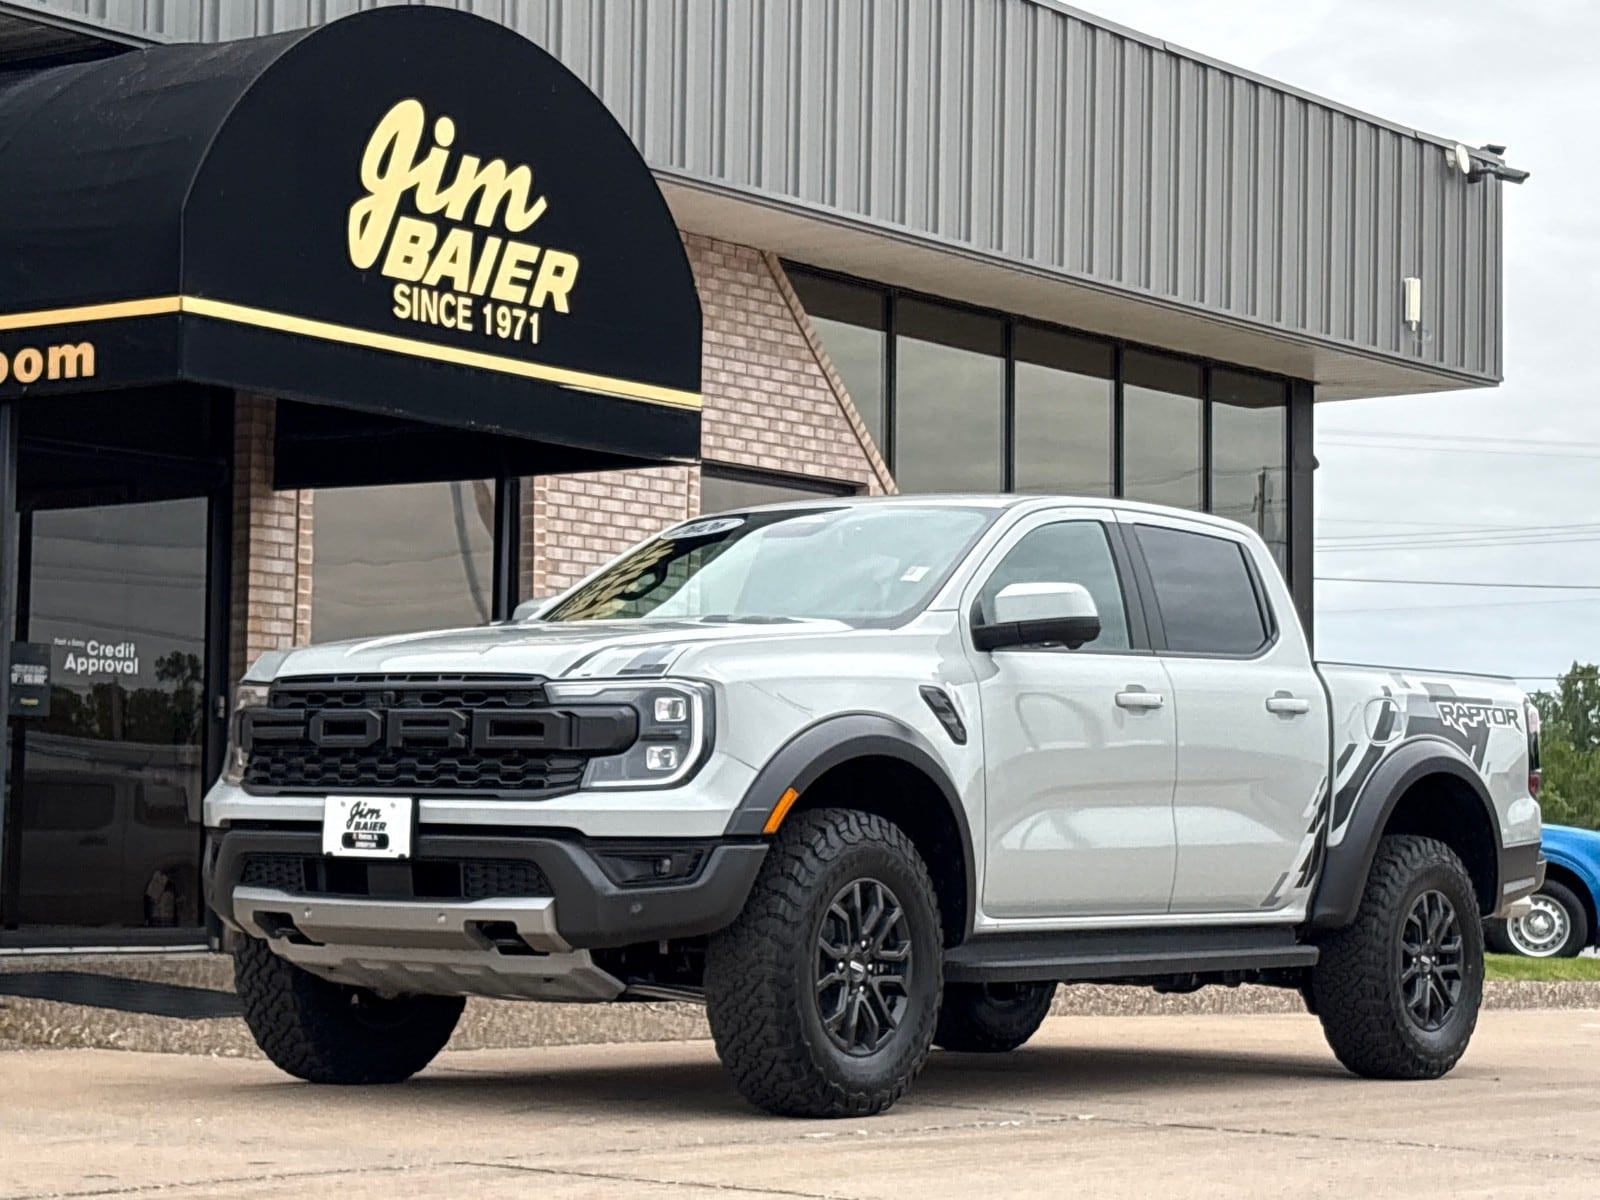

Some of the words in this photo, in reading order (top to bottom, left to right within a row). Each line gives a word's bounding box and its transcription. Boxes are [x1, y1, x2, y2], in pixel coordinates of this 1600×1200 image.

[348, 99, 548, 269] Jim
[381, 216, 579, 314] BAIER
[393, 283, 473, 332] SINCE
[483, 303, 540, 345] 1971
[0, 342, 95, 384] om
[63, 652, 139, 675] Approval
[86, 640, 136, 659] Credit
[239, 708, 571, 752] FORD
[1436, 701, 1525, 738] RAPTOR
[346, 801, 382, 831] Jim
[353, 821, 387, 832] BAIER
